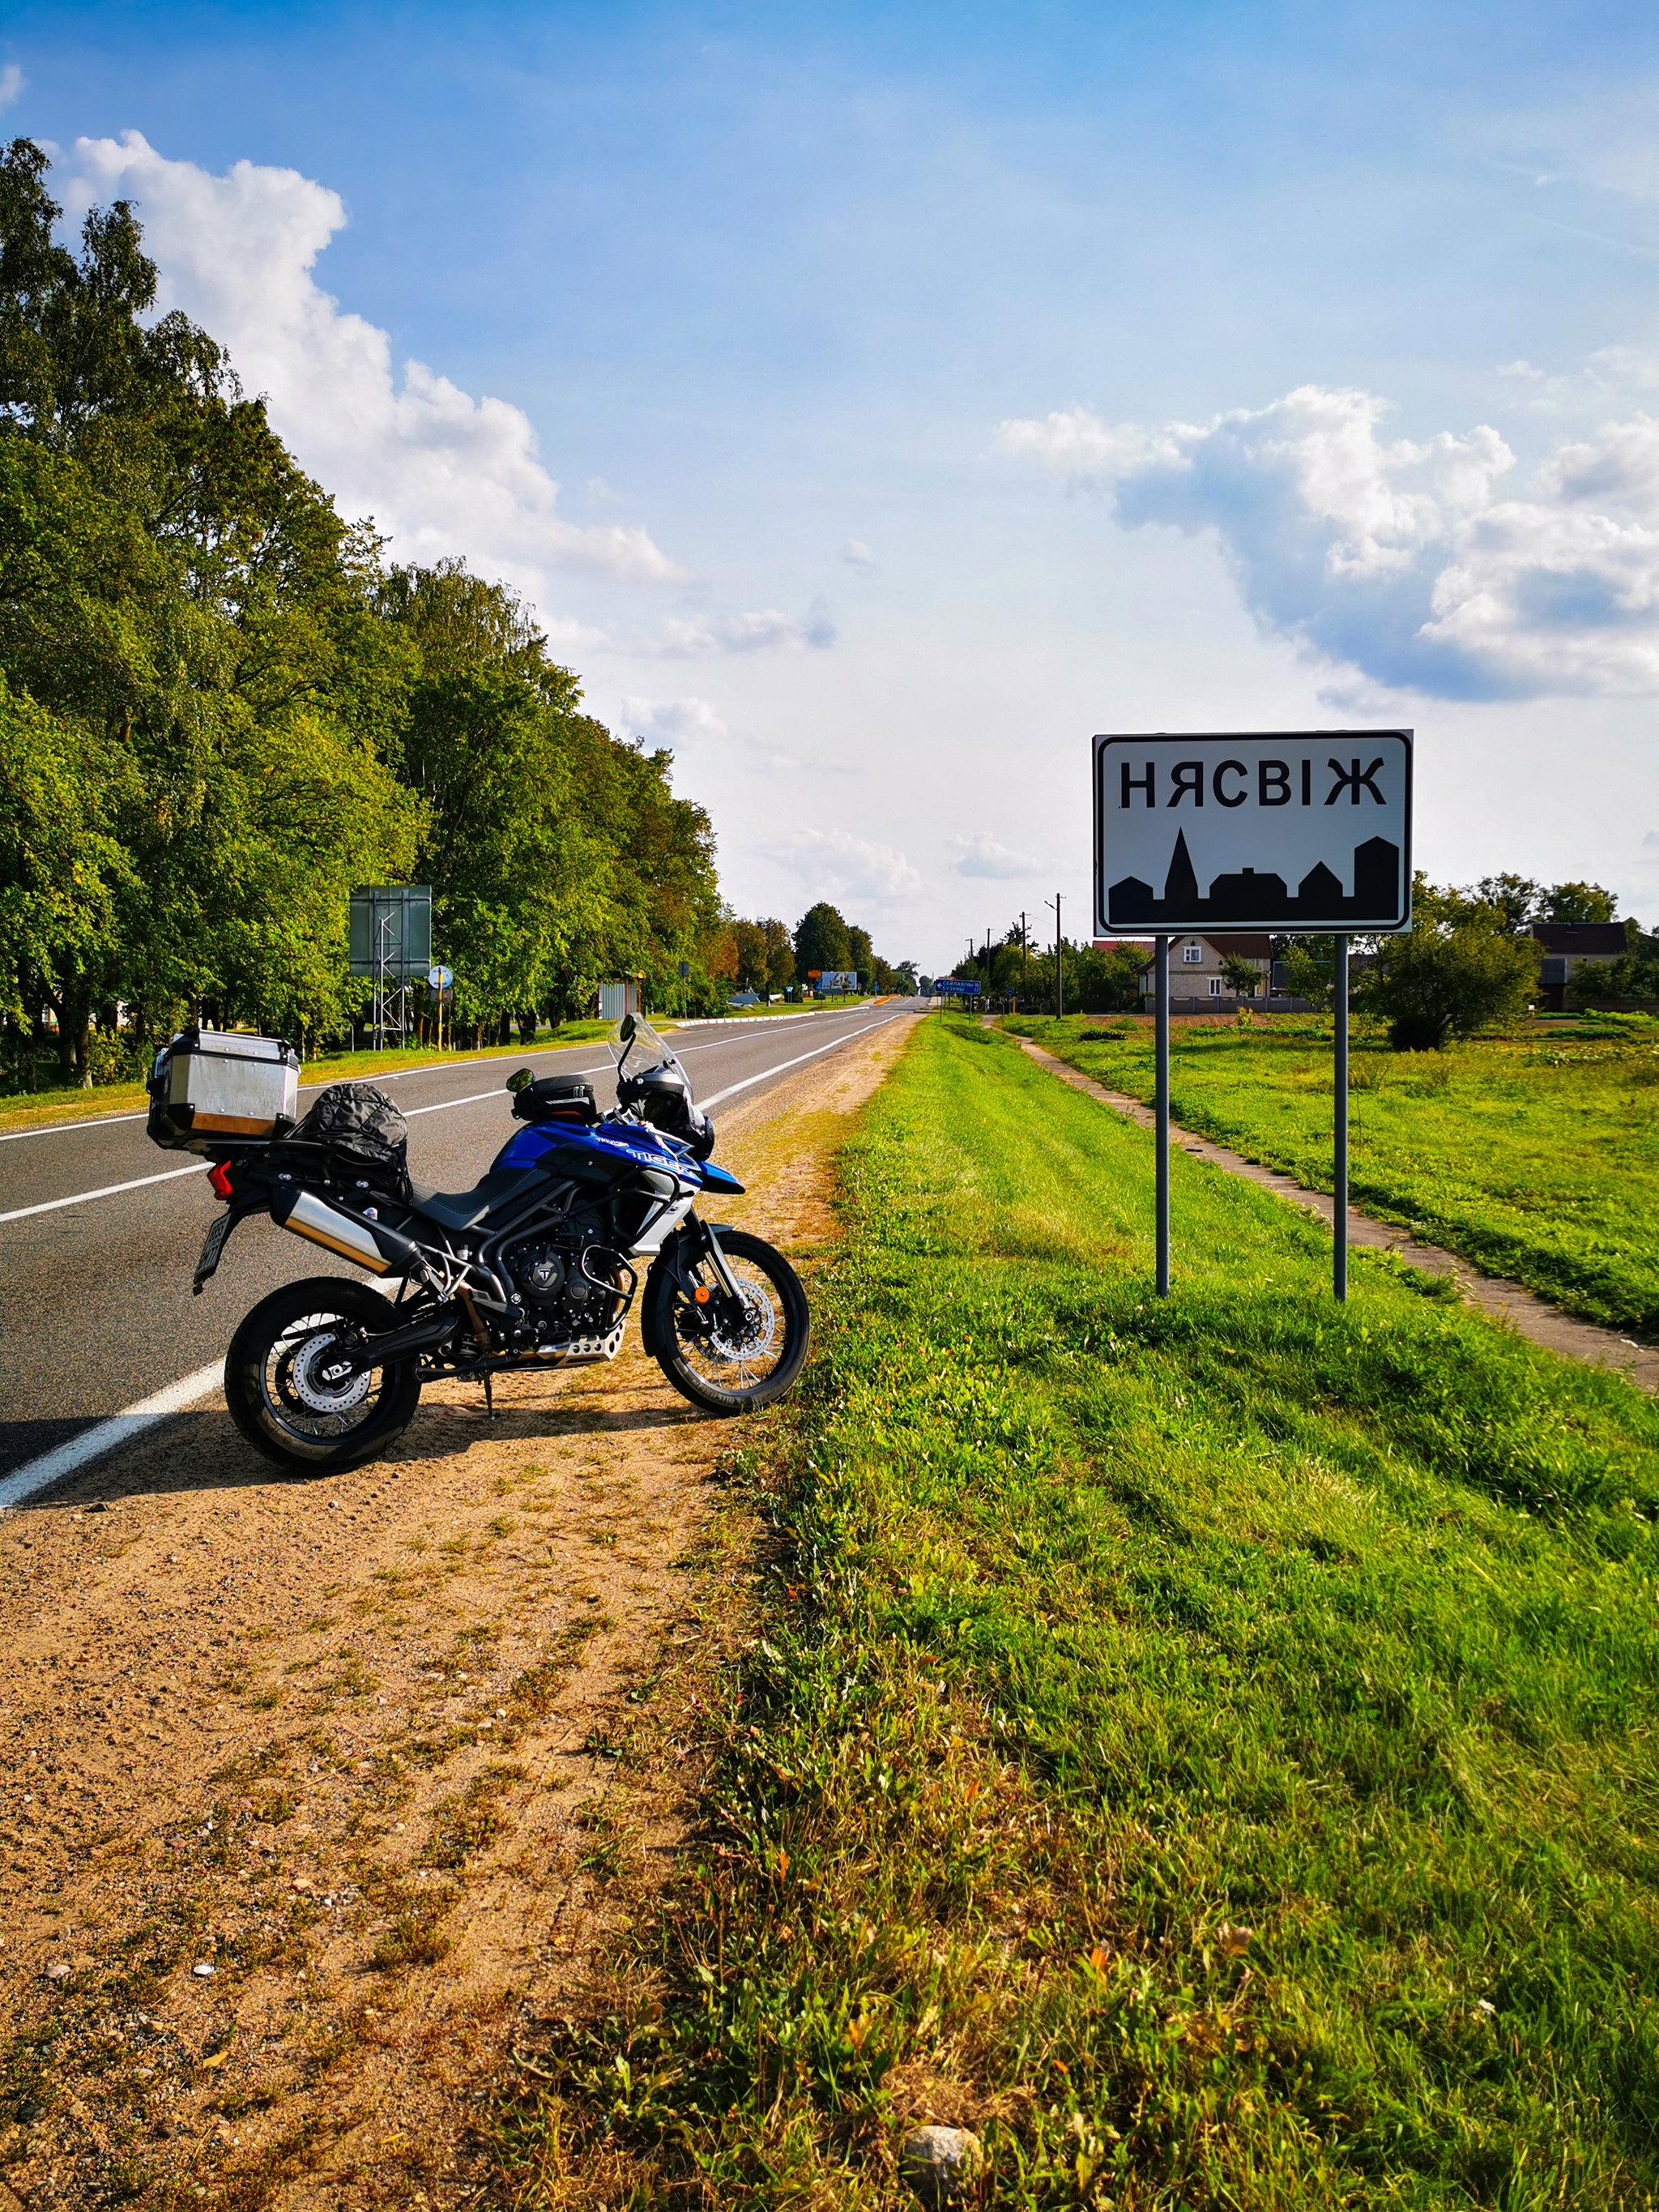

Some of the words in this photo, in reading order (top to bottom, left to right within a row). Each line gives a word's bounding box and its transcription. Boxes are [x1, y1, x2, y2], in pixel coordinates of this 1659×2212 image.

[1120, 757, 1387, 809] НЯСВІЖ
[625, 1149, 693, 1176] TIGER
[690, 1377, 736, 1406] MICHELIN
